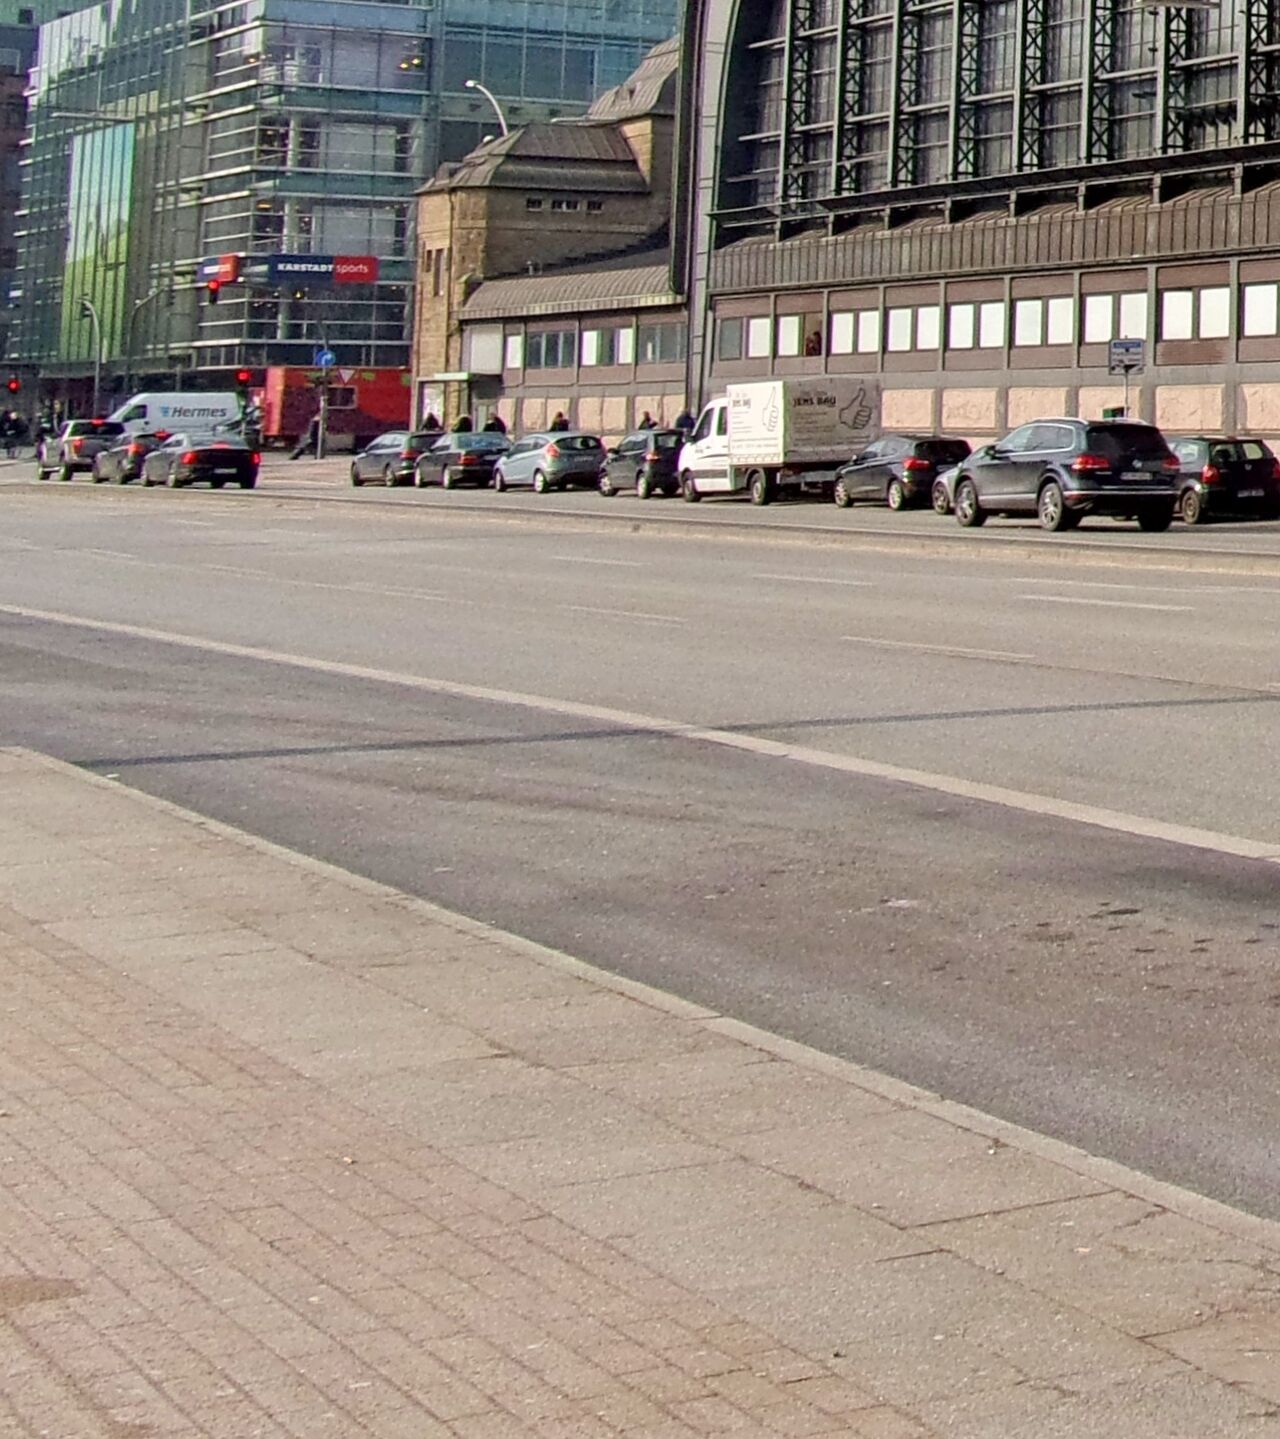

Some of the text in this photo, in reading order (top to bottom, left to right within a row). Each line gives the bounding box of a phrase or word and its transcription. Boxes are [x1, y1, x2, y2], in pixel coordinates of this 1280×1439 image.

[277, 263, 369, 274] KARSTADT sports
[171, 406, 227, 417] Hermes
